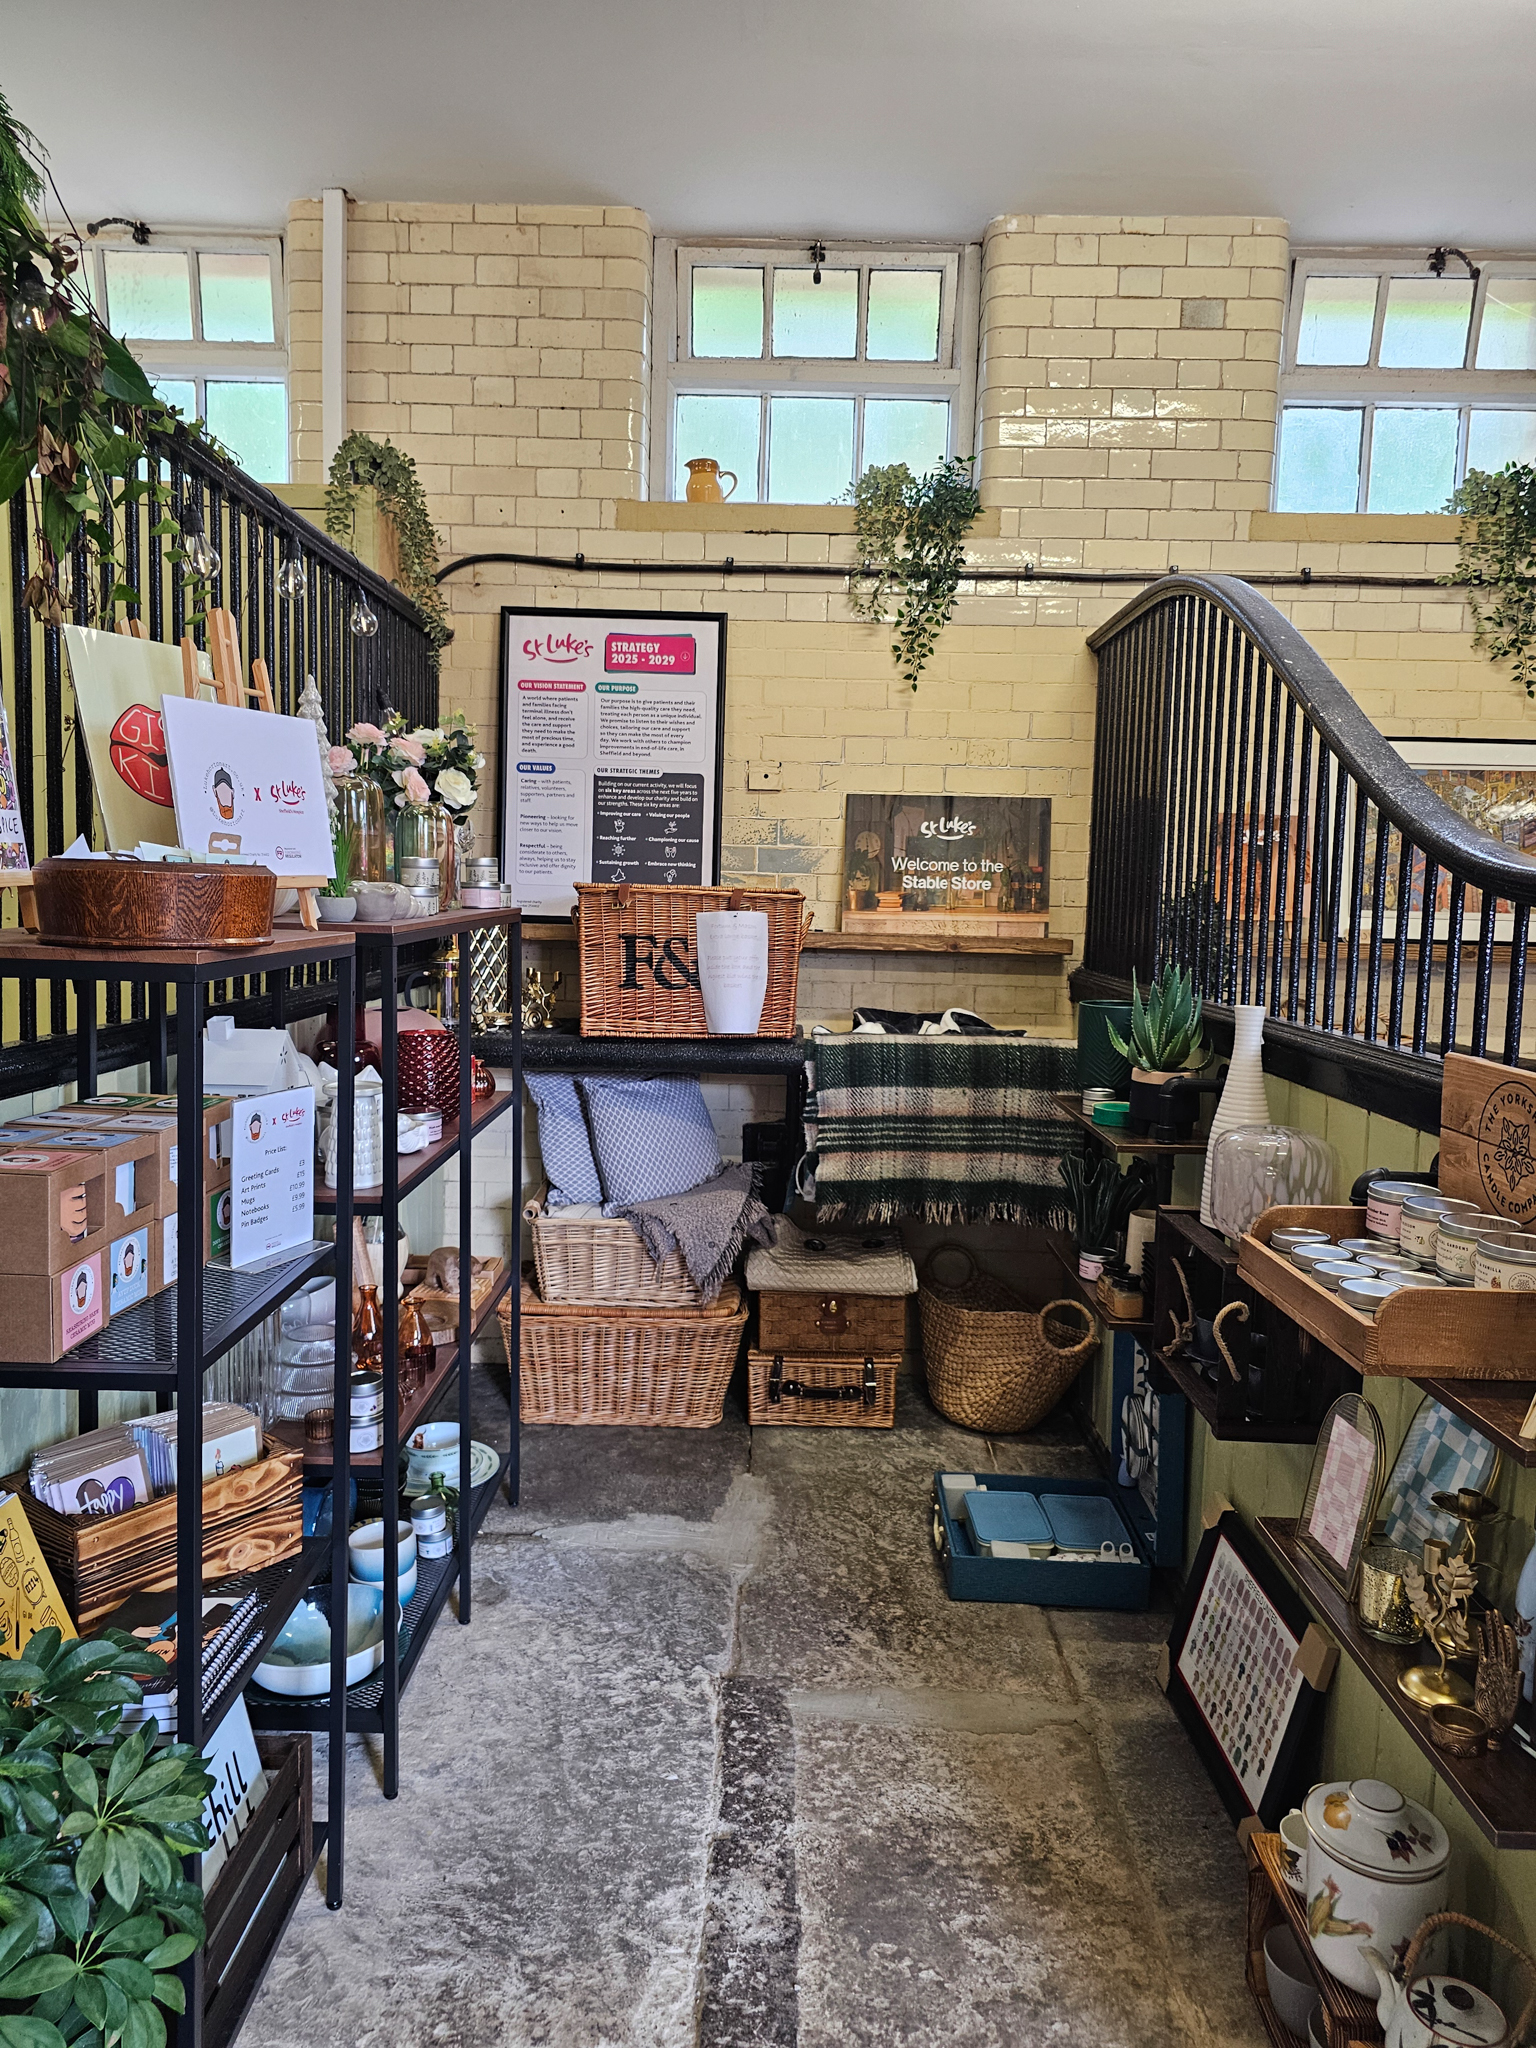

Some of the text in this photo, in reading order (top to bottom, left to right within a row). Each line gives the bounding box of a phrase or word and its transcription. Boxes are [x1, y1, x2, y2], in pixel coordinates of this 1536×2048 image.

[547, 633, 594, 658] Luke's
[611, 642, 660, 653] STRATEGY
[612, 654, 638, 664] 2025
[649, 655, 675, 666] 2029
[282, 780, 306, 800] Luke's
[940, 816, 977, 836] Luke's
[891, 856, 1003, 873] Welcome to the
[903, 875, 991, 890] Stable Store
[289, 1107, 305, 1118] Luke's
[1485, 1104, 1499, 1132] THE
[265, 1145, 287, 1156] Price List:
[241, 1167, 279, 1183] Greeting Cards
[297, 1170, 305, 1178] £15
[1483, 1153, 1507, 1207] CANDLE
[241, 1183, 266, 1194] Art Prints
[289, 1181, 305, 1191] £10.99
[241, 1197, 255, 1205] Mugs
[292, 1192, 305, 1202] £9.99
[241, 1204, 269, 1217] Notebooks
[292, 1203, 305, 1213] £5.99
[250, 1215, 268, 1225] Badges
[1447, 1243, 1469, 1252] GARDENS
[1482, 1264, 1501, 1273] VANILLA
[70, 1319, 96, 1339] CERAMIC MUG
[1244, 1573, 1277, 1625] SHEFFIELD UNITED
